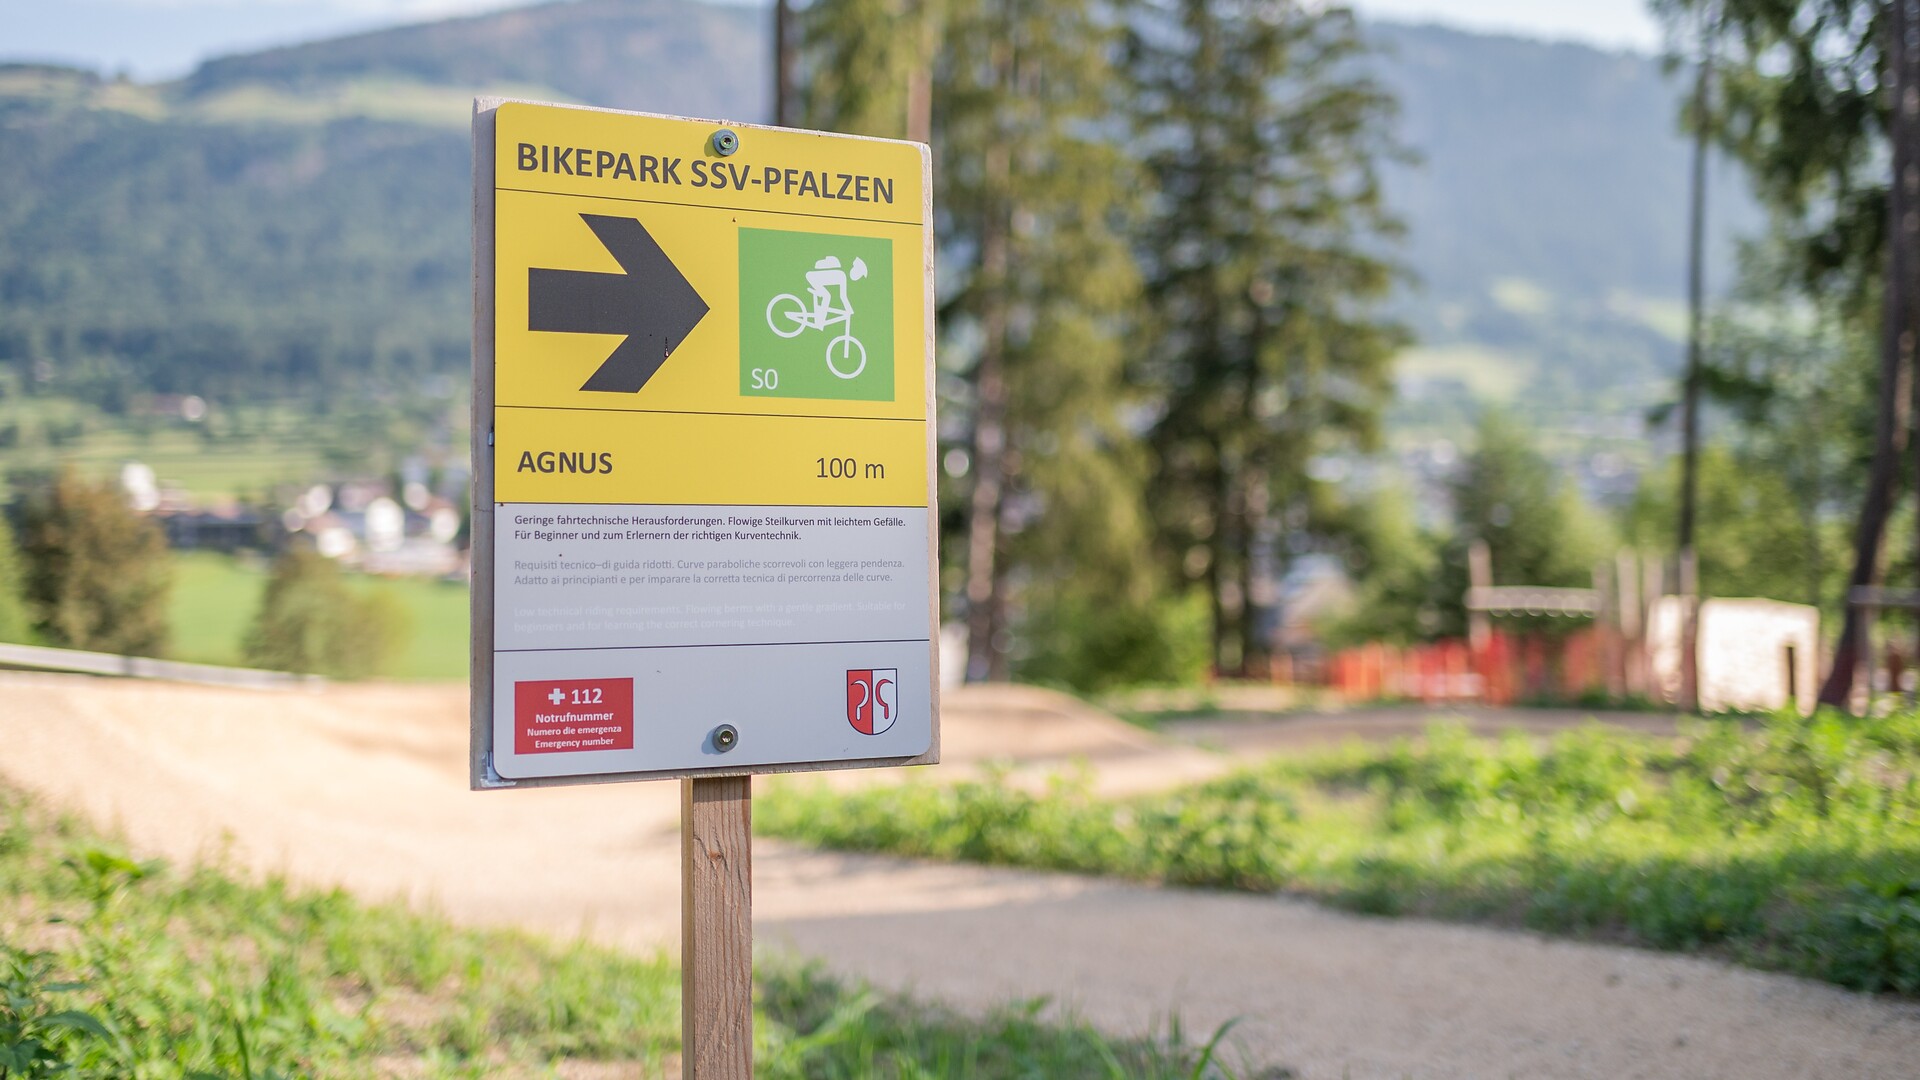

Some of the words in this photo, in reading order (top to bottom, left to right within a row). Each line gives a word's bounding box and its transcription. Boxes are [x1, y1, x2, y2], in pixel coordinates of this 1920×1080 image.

[517, 143, 682, 185] BIKEPARK
[690, 161, 893, 204] SSV-PFALZEN
[517, 451, 613, 474] AGNUS
[816, 457, 857, 479] 100
[865, 463, 885, 479] m
[514, 515, 554, 527] Geringe
[556, 515, 629, 525] fahrtechnische
[631, 516, 726, 527] Herausforderungen.
[728, 516, 763, 527] Flowige
[765, 516, 815, 526] Steilkurven
[817, 517, 832, 526] mit
[834, 517, 871, 526] leichtem
[873, 517, 906, 527] Gefälle.
[514, 531, 531, 540] Für
[534, 531, 578, 541] Beginner
[581, 531, 600, 540] und
[626, 531, 671, 540] Erlernern
[673, 531, 689, 540] der
[692, 531, 732, 541] richtigen
[734, 531, 802, 540] Kurventechnik.
[514, 560, 557, 571] Requisiti
[613, 560, 640, 571] guida
[642, 560, 675, 569] ridotti.
[677, 560, 704, 569] Curve
[707, 559, 760, 570] paraboliche
[763, 559, 806, 568] scorrevoli
[826, 559, 858, 570] leggera
[860, 559, 905, 569] pendenza.
[514, 575, 548, 585] Adatto
[551, 575, 560, 585] ai
[562, 575, 618, 587] principianti
[620, 576, 627, 584] e
[629, 576, 645, 586] per
[647, 575, 691, 586] imparare
[693, 574, 701, 583] la
[703, 574, 740, 584] corretta
[743, 573, 775, 583] tecnica
[777, 573, 786, 582] di
[788, 574, 841, 584] percorrenza
[843, 572, 864, 582] delle
[866, 574, 893, 582] curve.
[571, 688, 603, 705] 112
[535, 712, 614, 724] Notrufnummer
[527, 727, 562, 737] Numero
[562, 726, 576, 735] die
[577, 725, 622, 736] emergenza
[535, 738, 581, 749] Emergency
[582, 737, 614, 747] number
